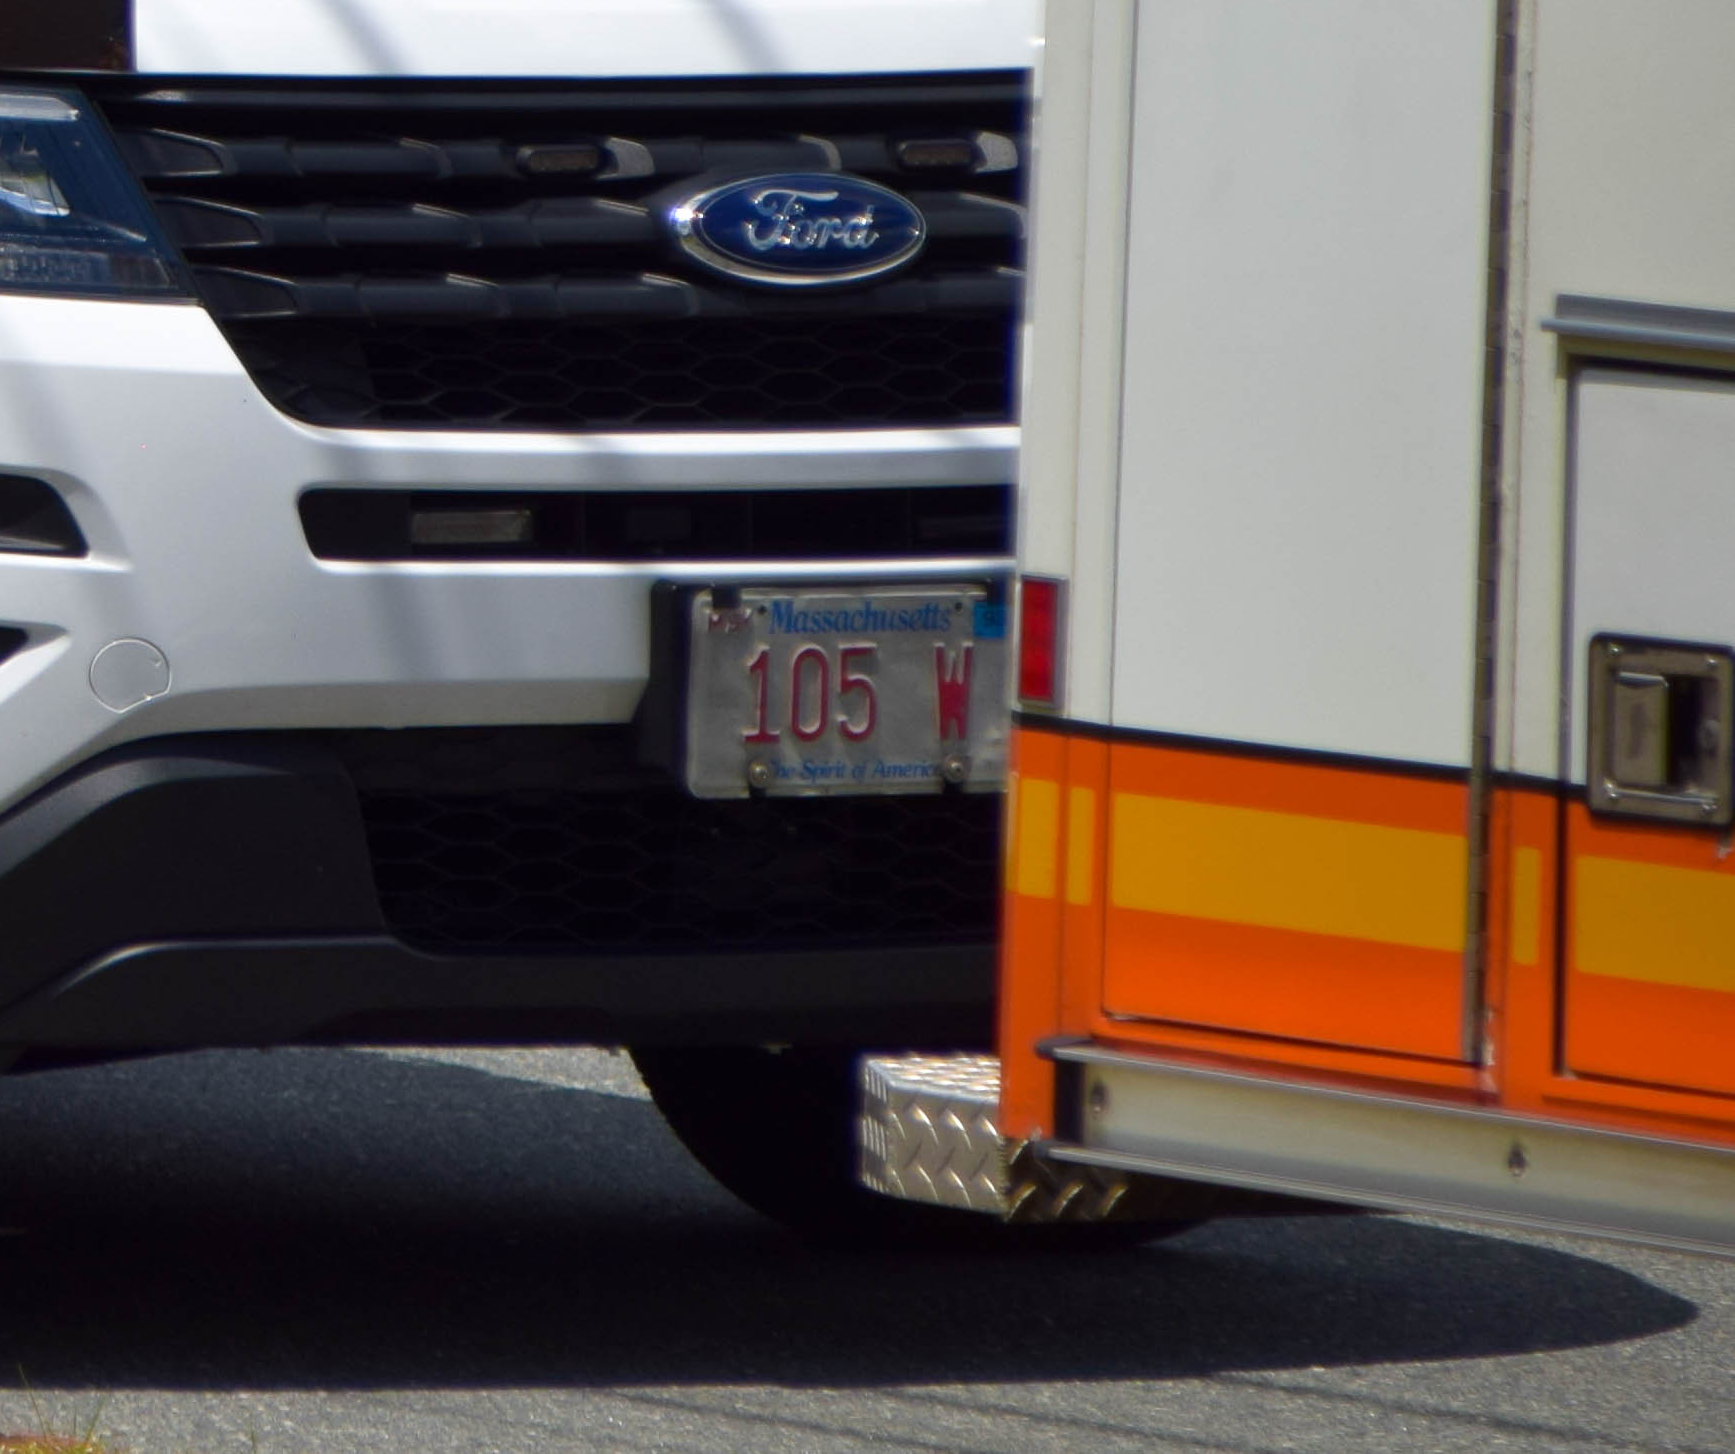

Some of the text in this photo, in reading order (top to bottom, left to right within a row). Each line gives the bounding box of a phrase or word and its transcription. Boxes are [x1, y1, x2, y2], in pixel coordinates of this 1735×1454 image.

[744, 187, 880, 251] Ford
[767, 599, 953, 635] Massachusetts
[742, 639, 975, 744] 105 W
[800, 757, 845, 785] Spirit
[850, 760, 869, 784] of
